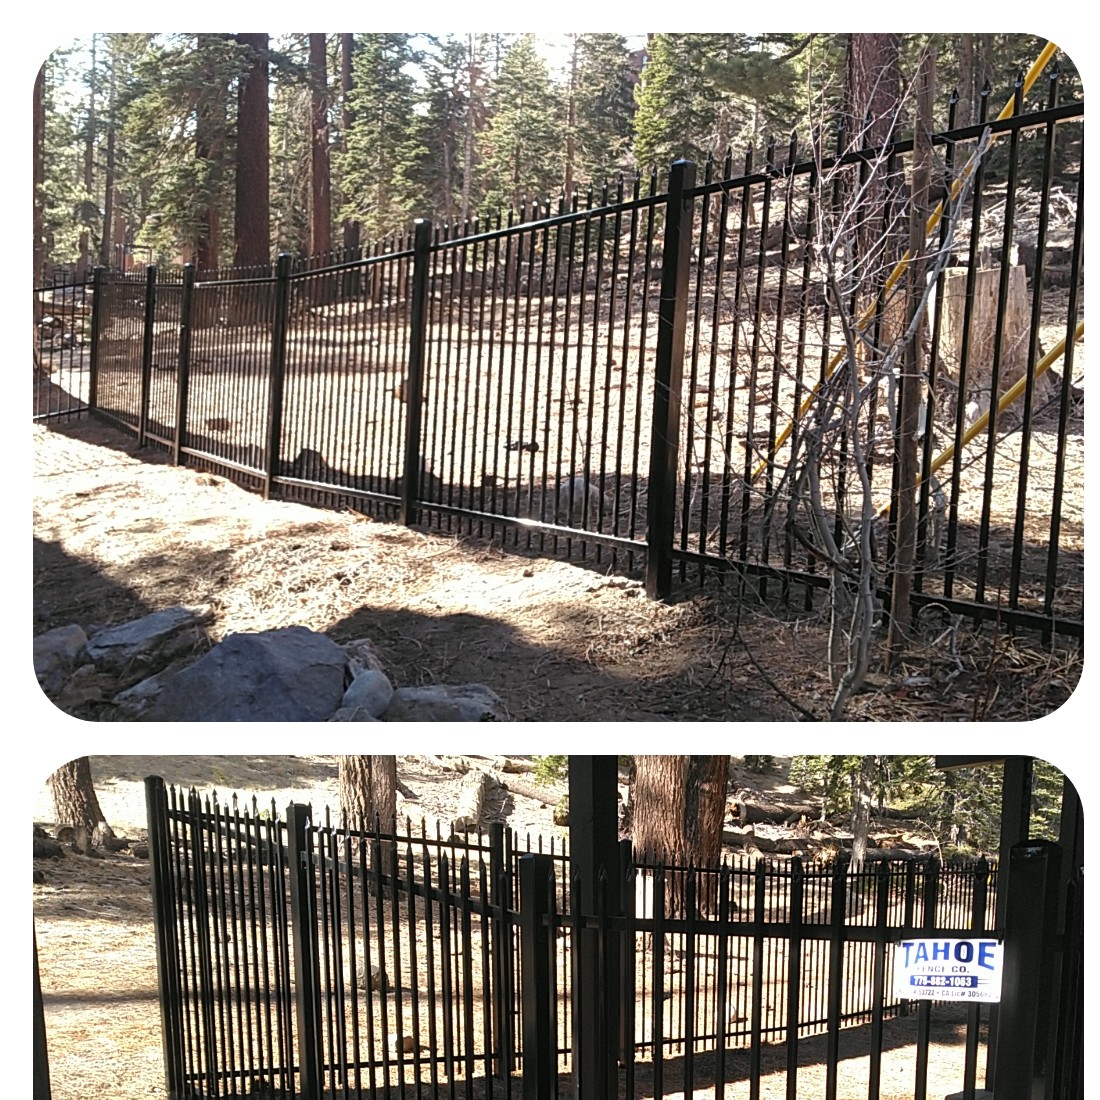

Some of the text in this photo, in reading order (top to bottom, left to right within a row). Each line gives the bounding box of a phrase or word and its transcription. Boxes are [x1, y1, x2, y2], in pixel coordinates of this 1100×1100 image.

[902, 941, 997, 971] TAHOE
[916, 965, 970, 973] ENCE CO.
[913, 975, 972, 987] 775-882-1063
